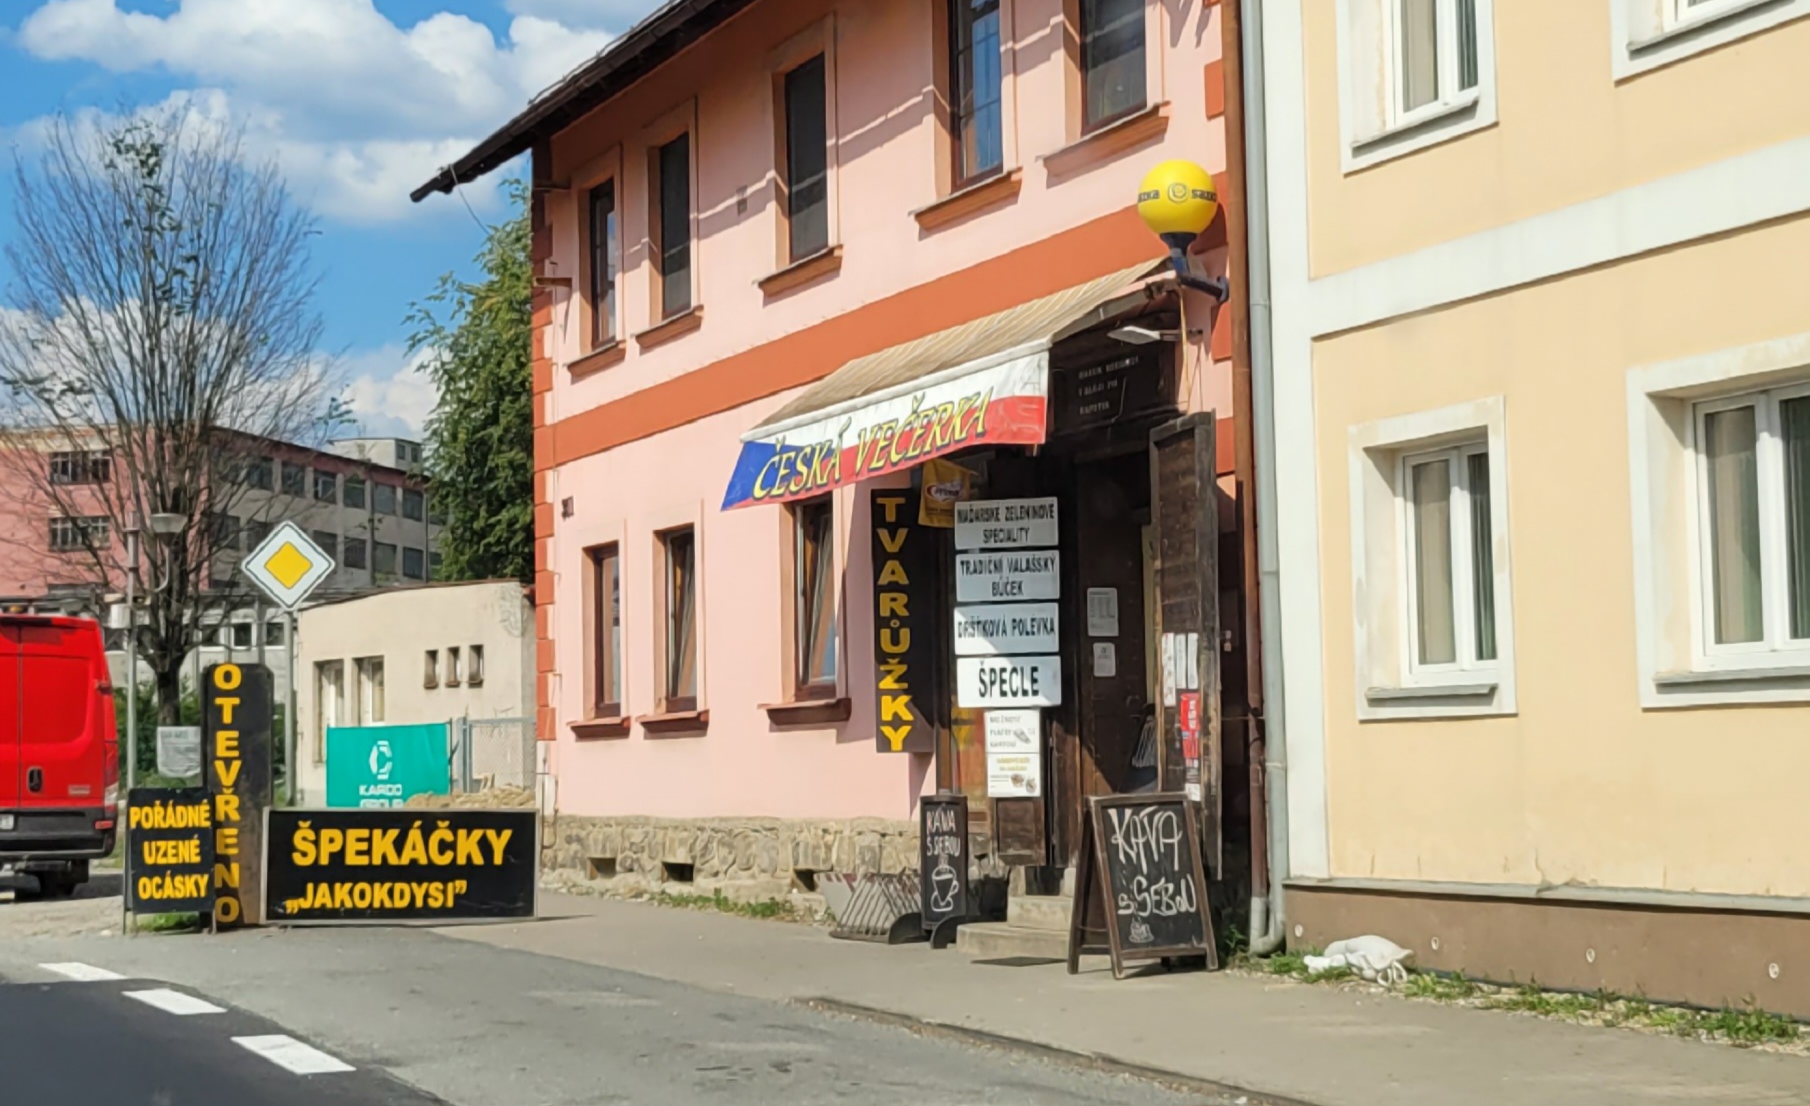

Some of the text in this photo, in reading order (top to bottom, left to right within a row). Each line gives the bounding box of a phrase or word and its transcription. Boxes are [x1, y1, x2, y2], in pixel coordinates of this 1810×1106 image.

[752, 385, 994, 500] ČESKÁ VEČERKA
[876, 496, 914, 752] TVARŮŽKY
[978, 659, 1040, 699] ŠPECLE
[213, 663, 241, 922] OTEVŘENO
[129, 799, 211, 830] POŘÁDNÉ
[143, 834, 202, 865] UZENÉ
[292, 820, 513, 866] ŠPEKÁČKY
[138, 870, 209, 900] OCÁSKY
